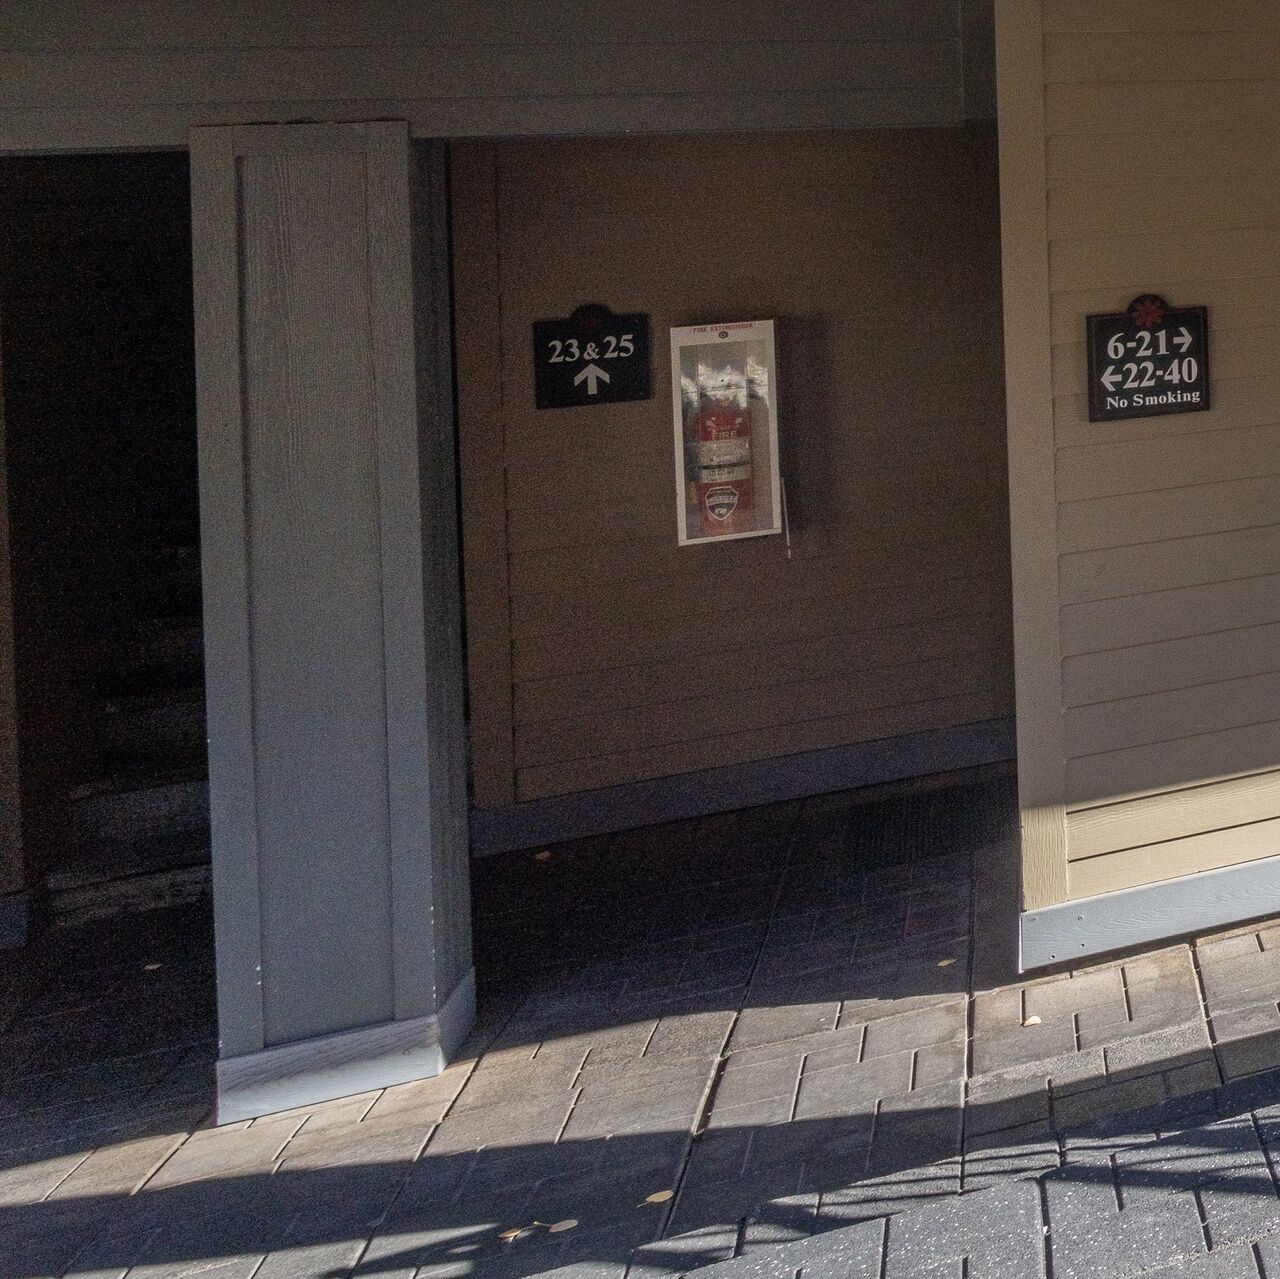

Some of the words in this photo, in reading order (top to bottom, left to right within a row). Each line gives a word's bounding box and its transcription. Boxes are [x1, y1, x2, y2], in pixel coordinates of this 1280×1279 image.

[1107, 329, 1170, 360] 6-21
[1122, 357, 1198, 389] 22-40
[1106, 396, 1129, 410] No
[1133, 390, 1201, 407] Smoking
